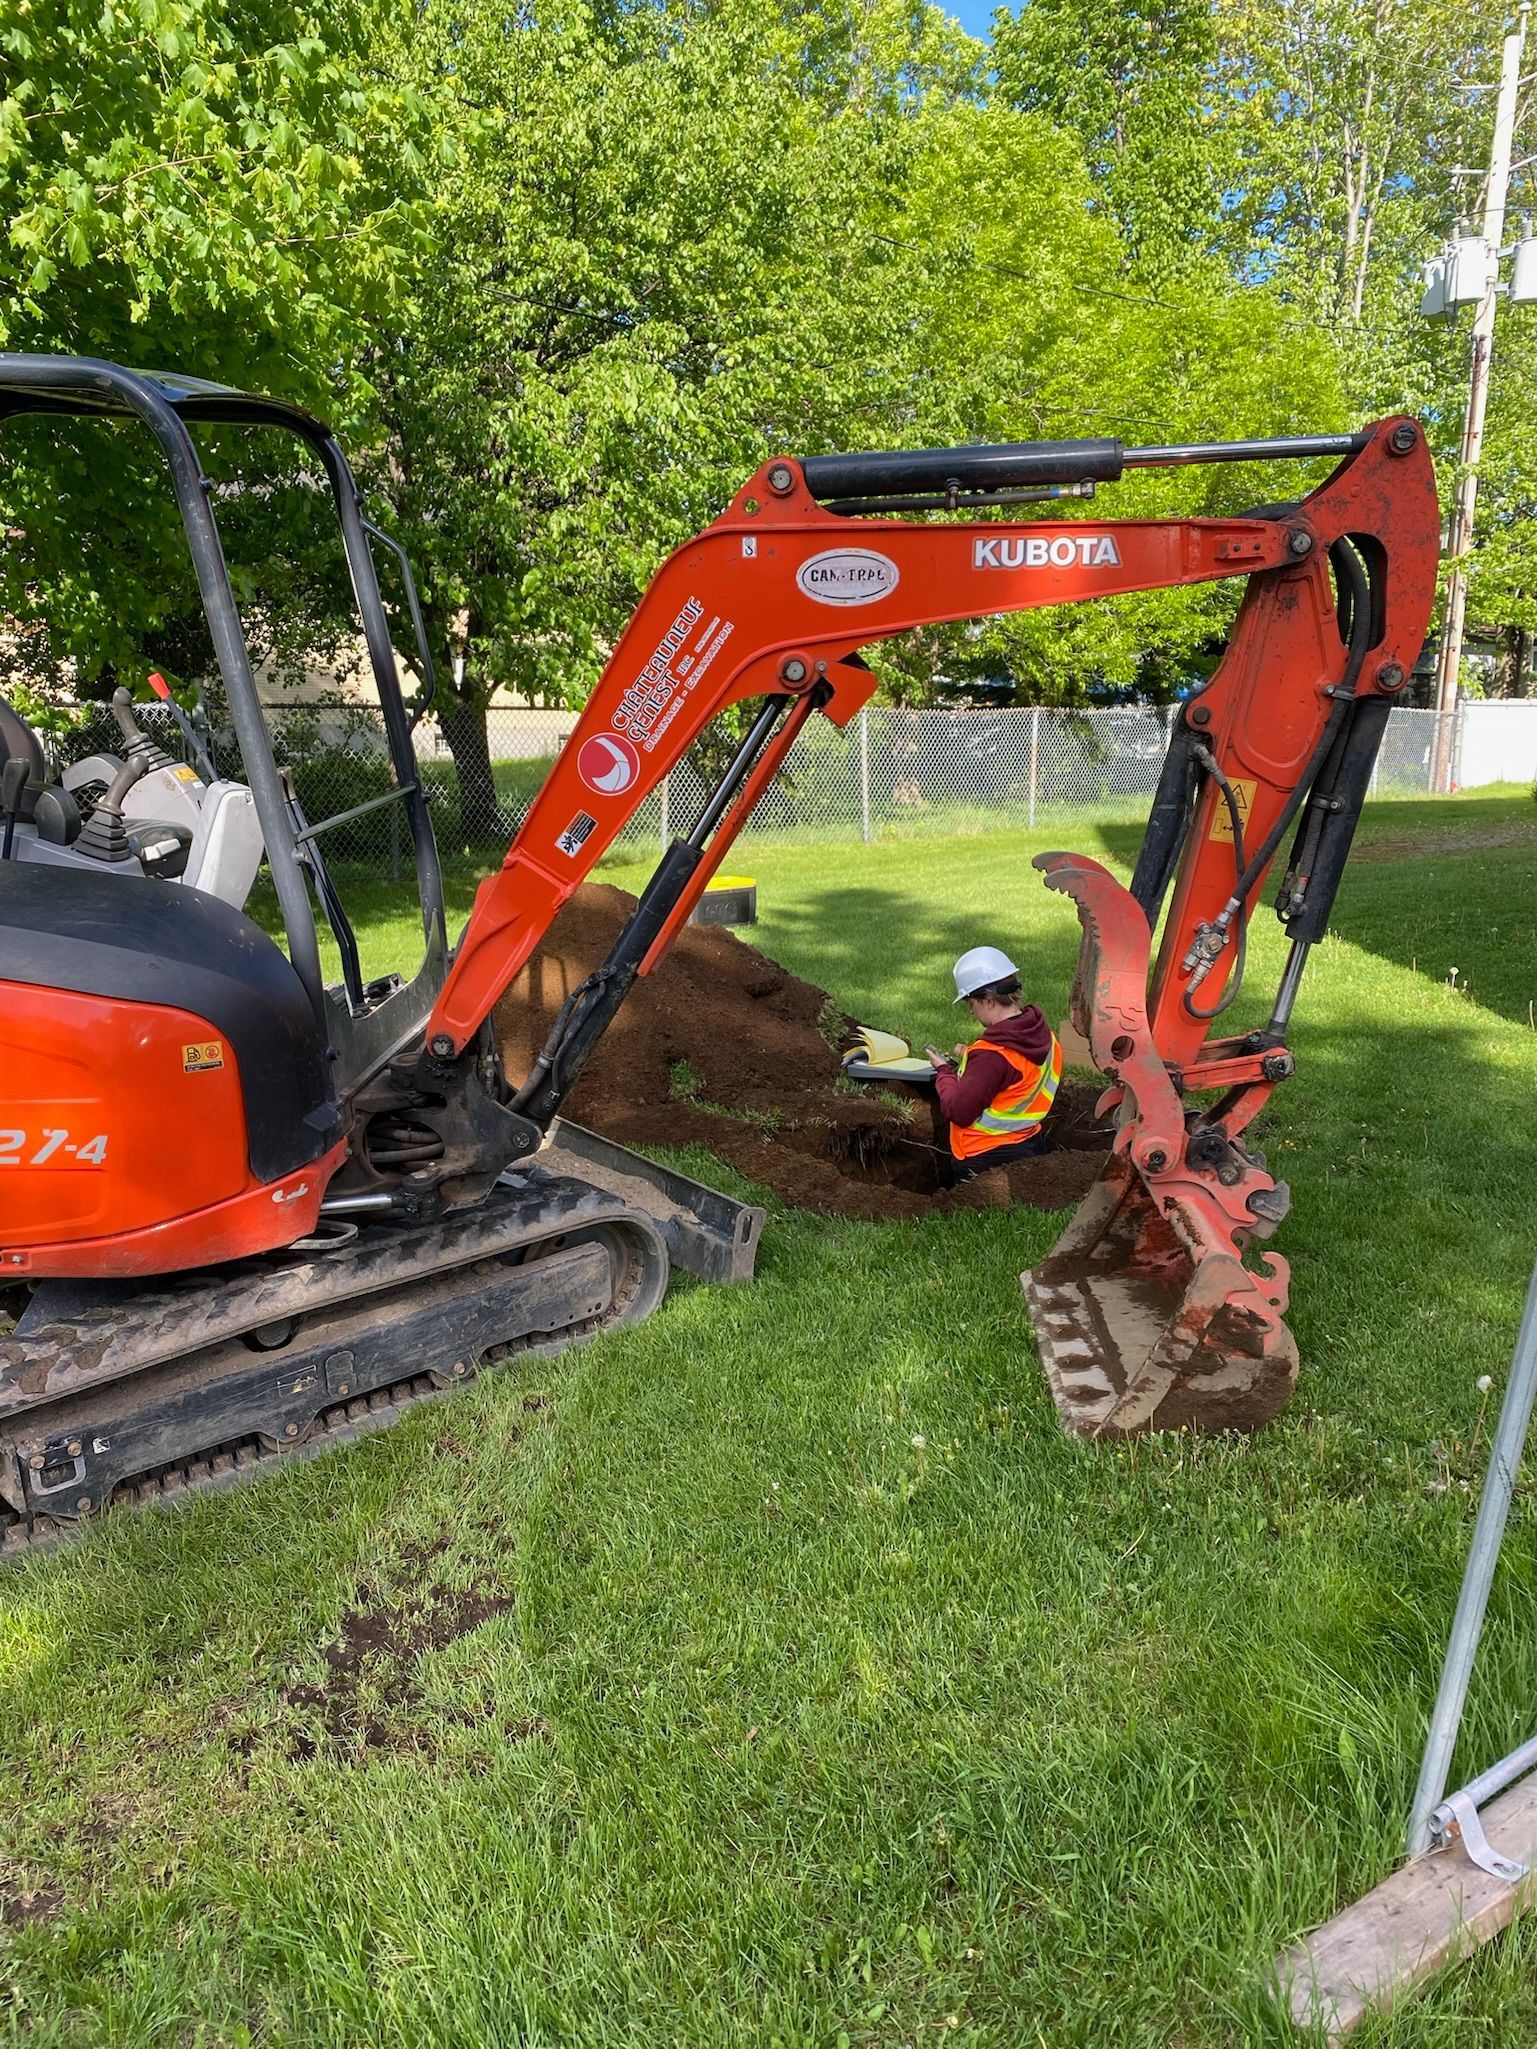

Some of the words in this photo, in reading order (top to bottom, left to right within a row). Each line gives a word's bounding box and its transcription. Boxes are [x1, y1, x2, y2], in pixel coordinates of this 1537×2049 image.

[974, 536, 1120, 567] KUBOTA
[611, 597, 704, 730] CHÂTEAUNEUF
[643, 695, 685, 752] DRAINAGE
[684, 621, 734, 690] EXCAVATION
[627, 670, 680, 742] GENEST
[0, 1128, 108, 1165] 27-4
